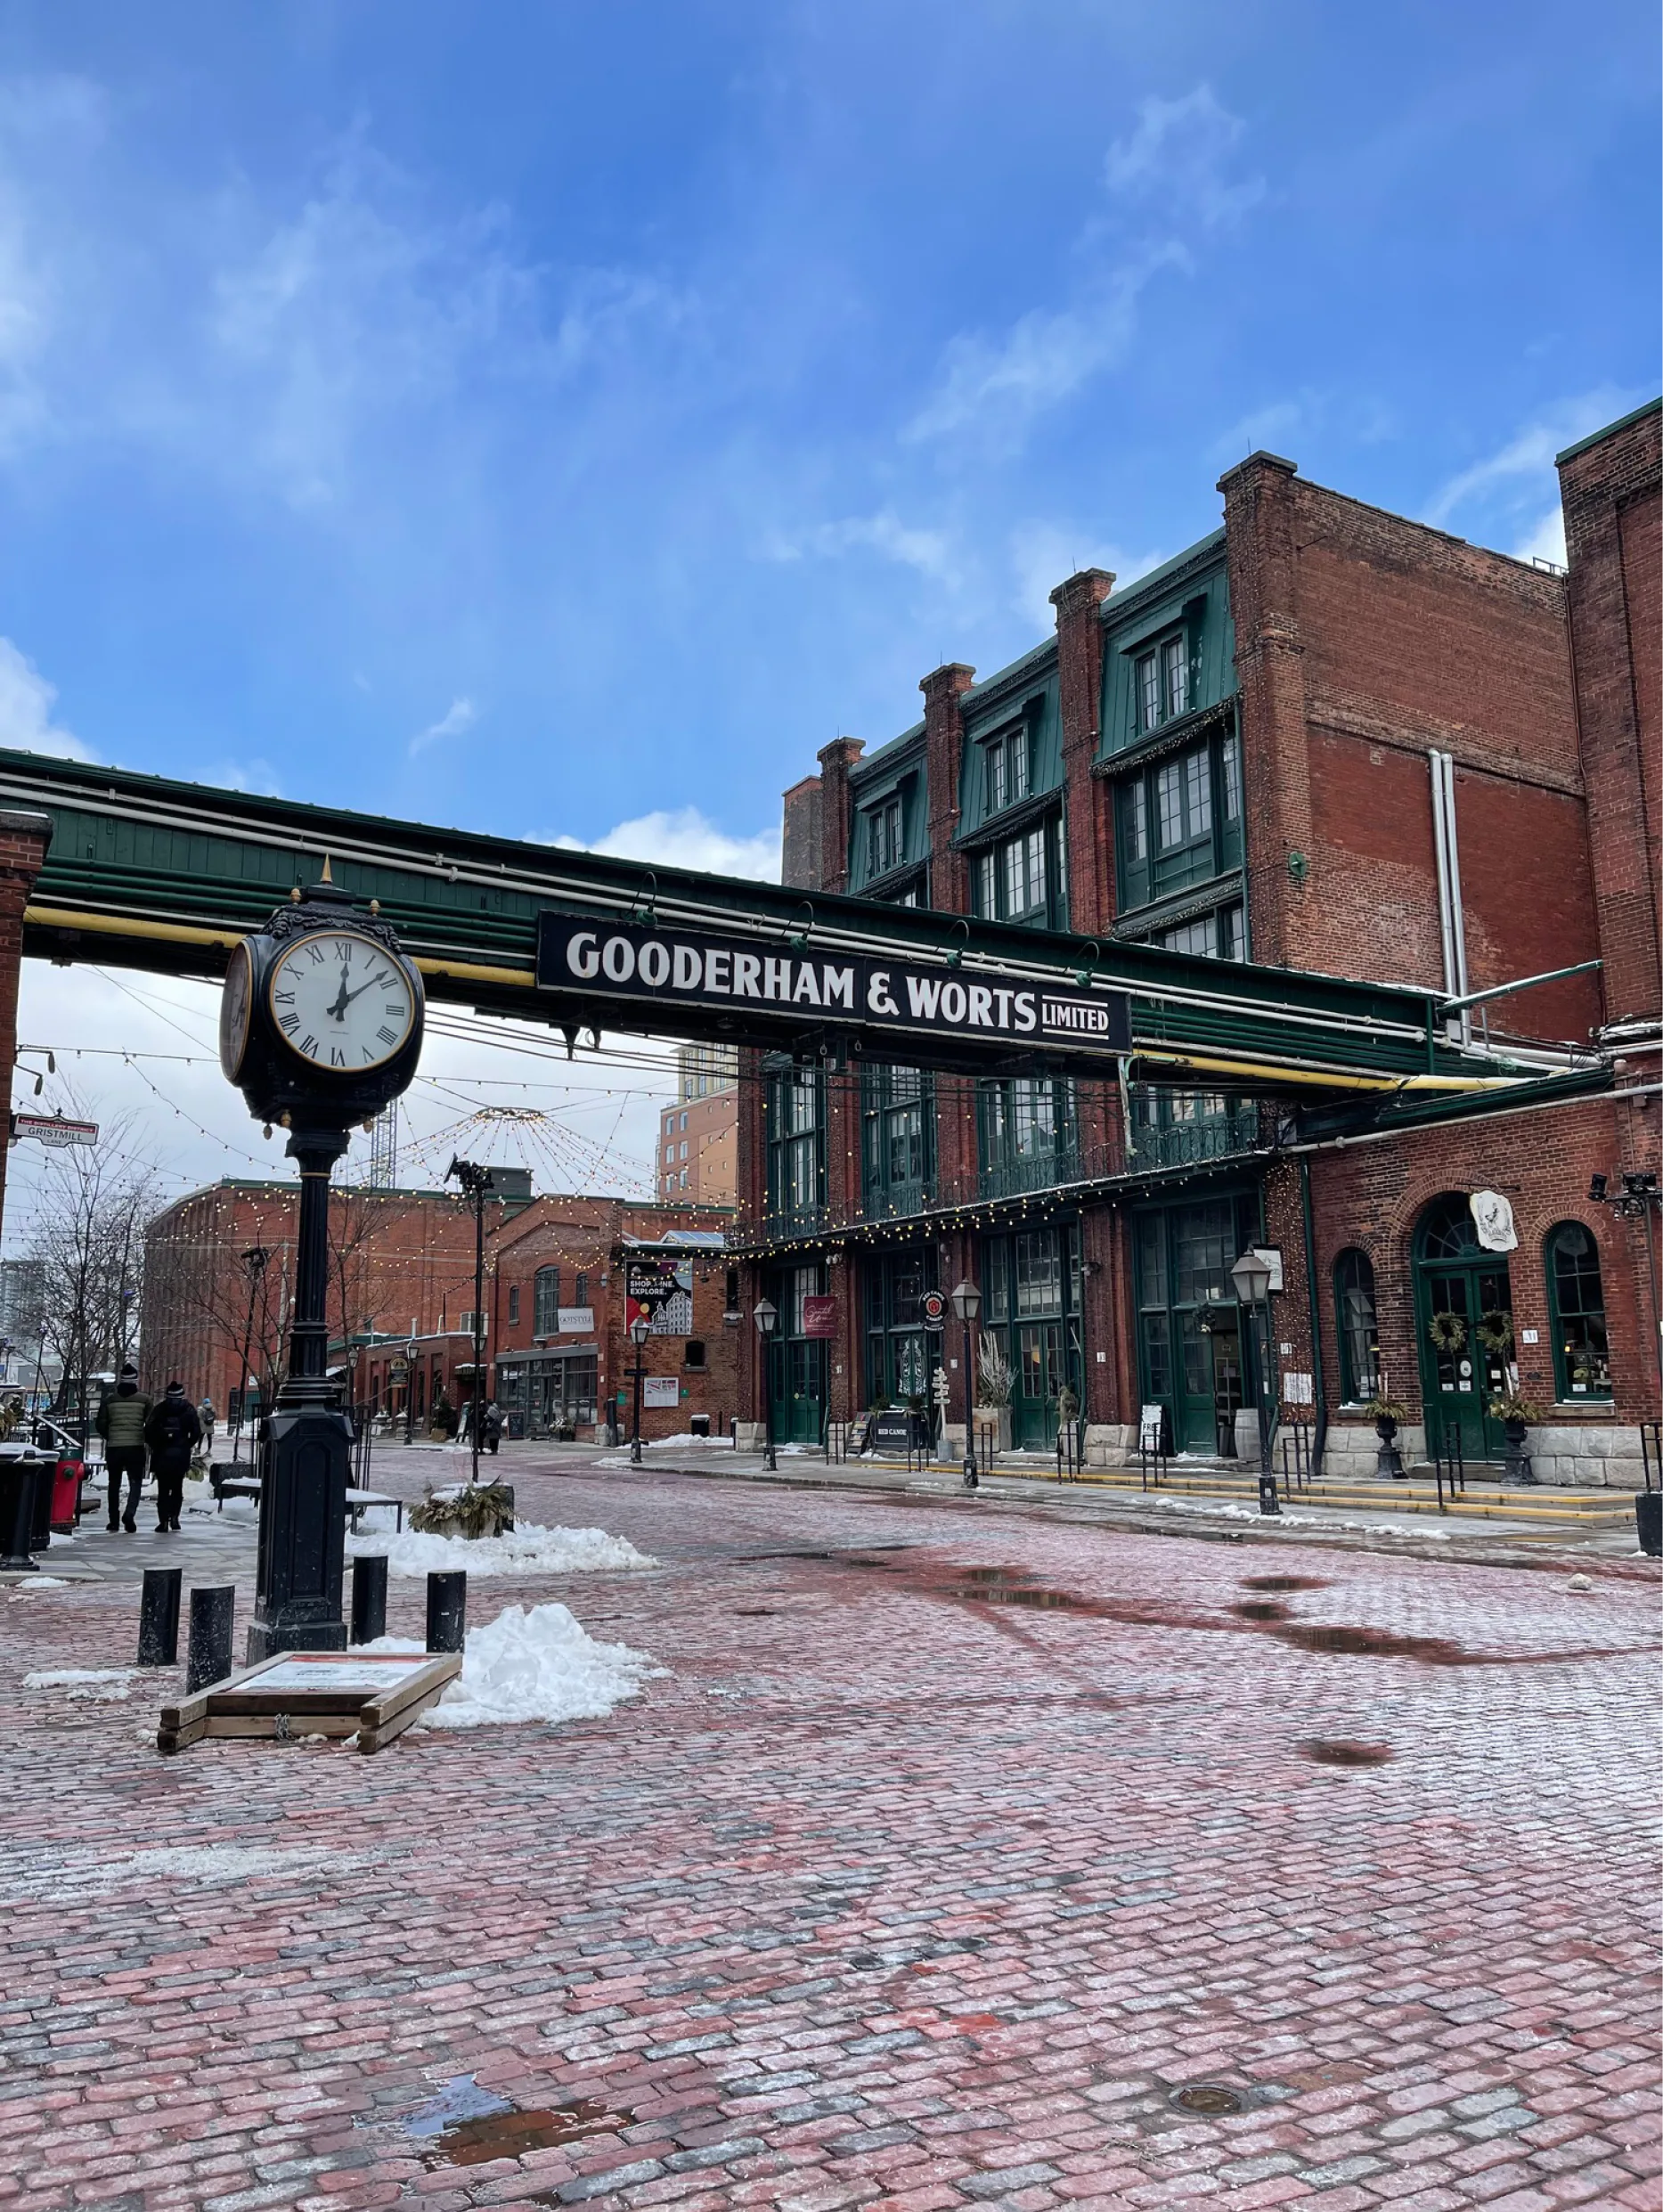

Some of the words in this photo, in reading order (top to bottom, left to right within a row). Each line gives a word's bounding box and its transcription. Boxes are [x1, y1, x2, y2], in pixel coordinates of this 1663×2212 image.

[305, 944, 326, 967] XI
[334, 941, 353, 962] XII
[282, 962, 305, 981] X
[379, 977, 399, 991] II
[566, 932, 855, 1010] GOODERHAM
[867, 971, 901, 1016] &
[905, 975, 1037, 1033] WORTS
[1041, 1000, 1110, 1033] LIMITED
[274, 989, 295, 1005] IX
[385, 1004, 405, 1017] III
[298, 1034, 320, 1059] VII
[330, 1047, 346, 1067] VI
[28, 1126, 83, 1141] GRISTMILL
[34, 1121, 67, 1130] DISTILLERY
